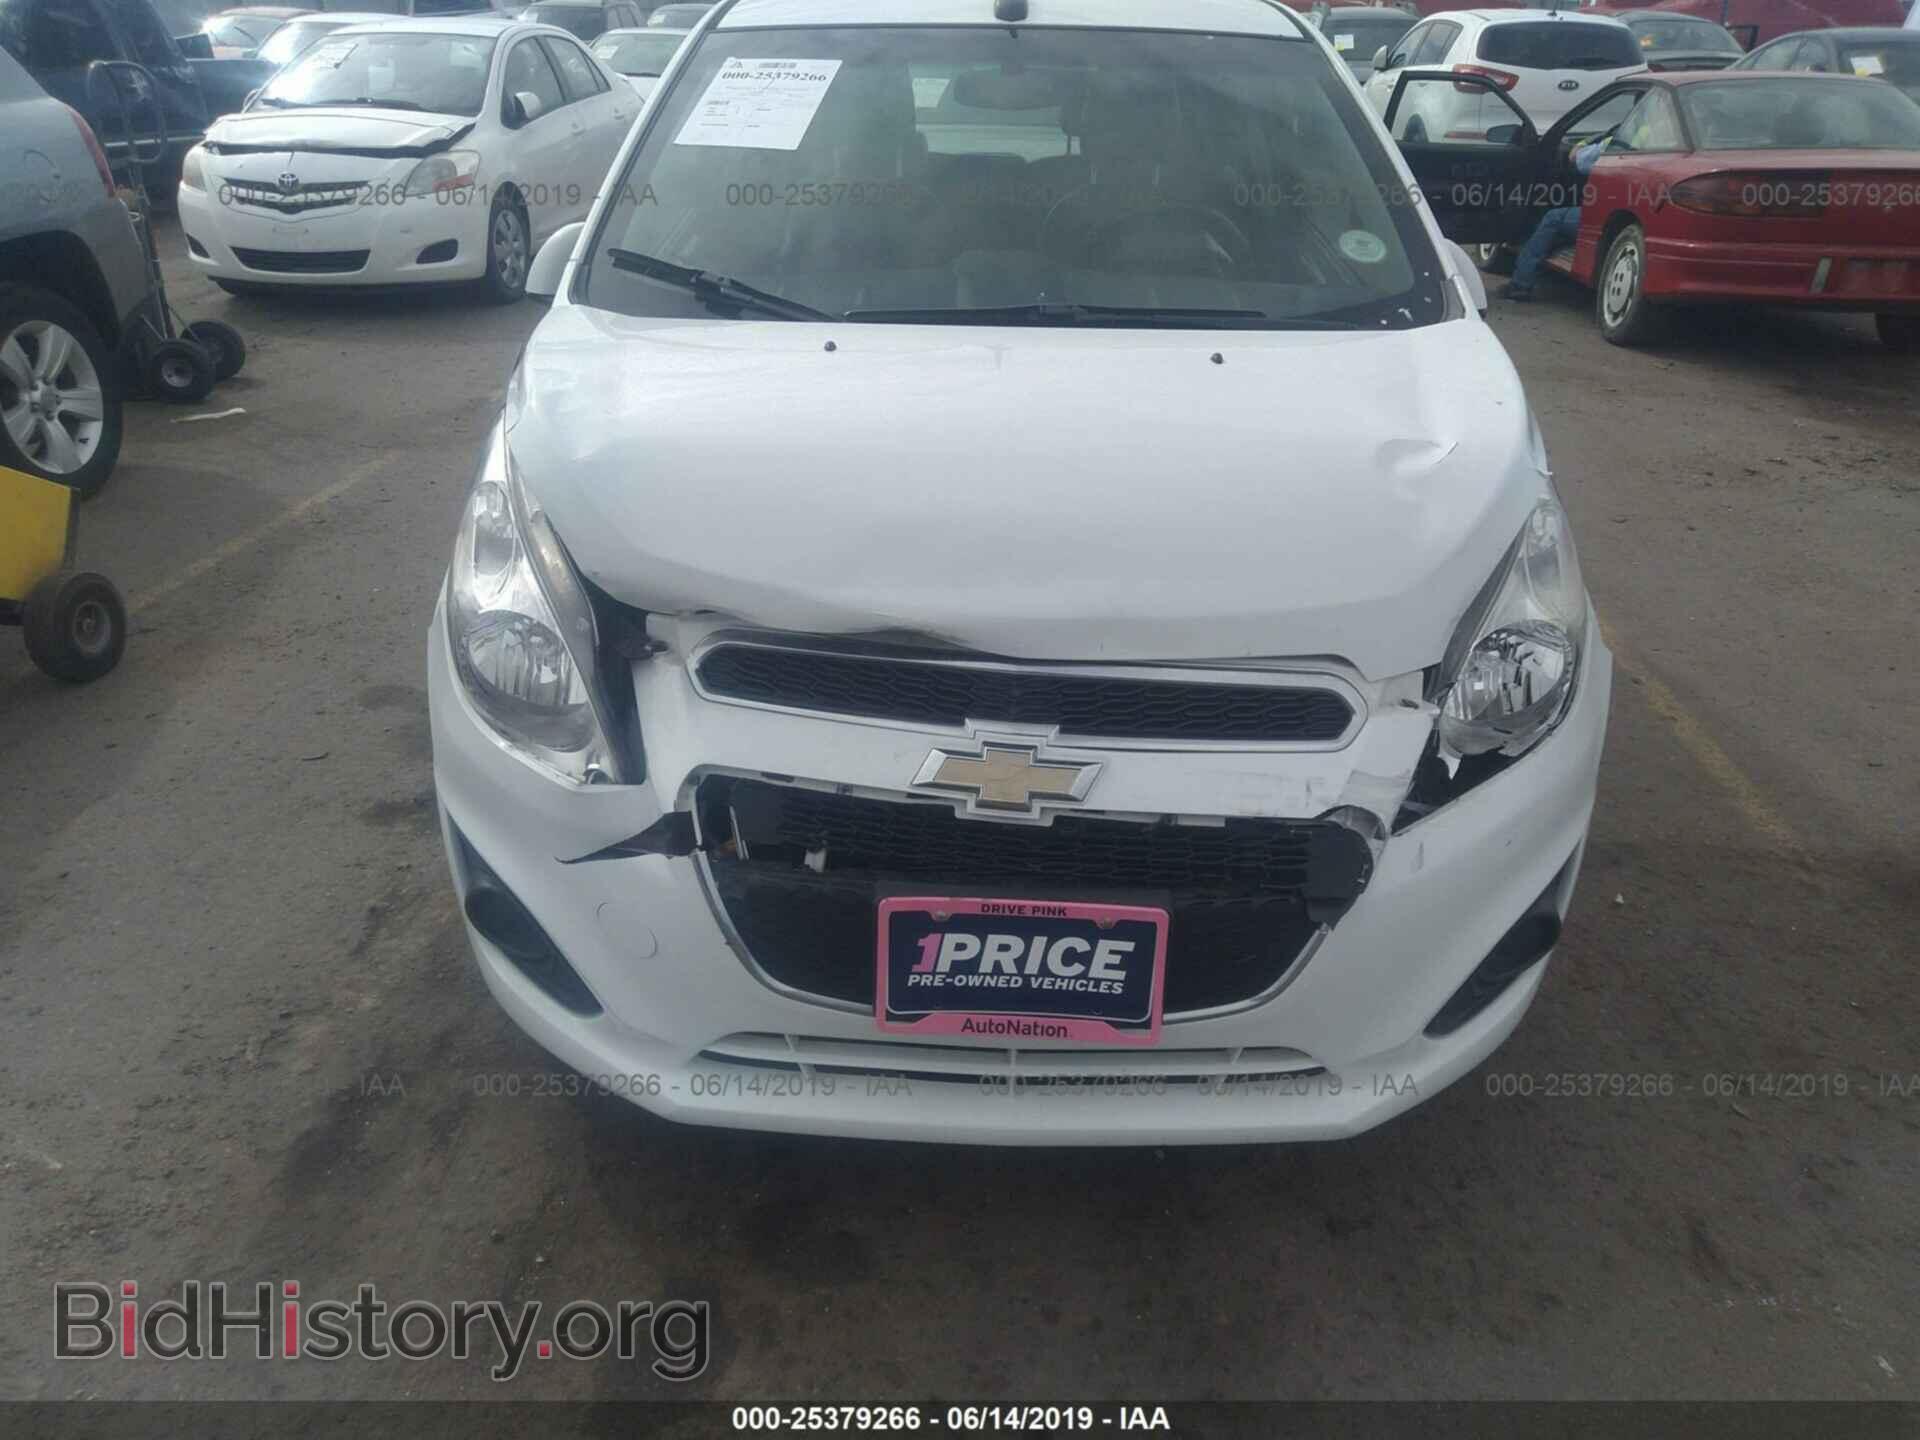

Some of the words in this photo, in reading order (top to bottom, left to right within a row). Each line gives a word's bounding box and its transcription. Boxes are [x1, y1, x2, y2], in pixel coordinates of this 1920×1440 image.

[980, 903, 1026, 915] DRIVE
[1032, 905, 1068, 917] PINK
[912, 932, 1135, 981] 1PRICE
[907, 973, 1023, 989] PRE-OWNED
[1030, 976, 1124, 995] VEHICLES
[960, 1017, 1069, 1038] AutoNation
